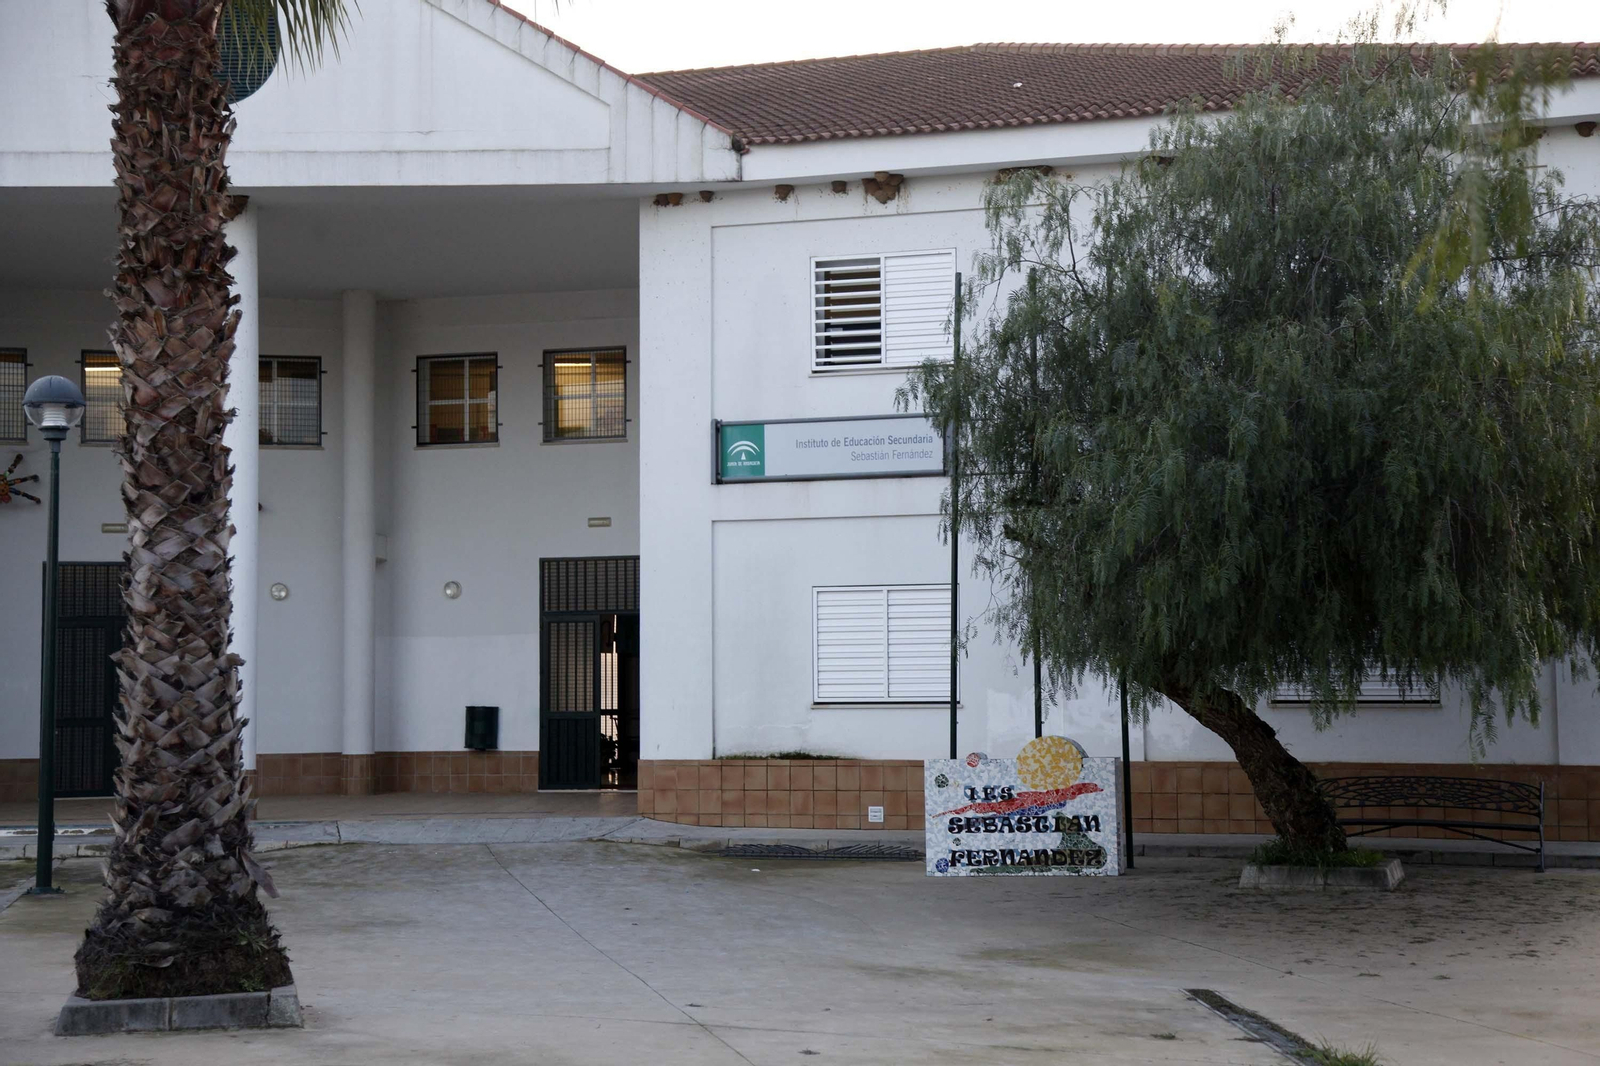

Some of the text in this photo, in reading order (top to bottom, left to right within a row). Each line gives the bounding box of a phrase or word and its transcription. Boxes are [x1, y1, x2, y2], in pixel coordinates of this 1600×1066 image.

[795, 434, 933, 449] Instituto de Educación Secundaria
[850, 448, 933, 461] Sebastián Fernández
[968, 786, 1013, 800] IES
[948, 815, 1101, 834] SEBASTIAN
[949, 849, 1102, 867] FERNANDEZ
